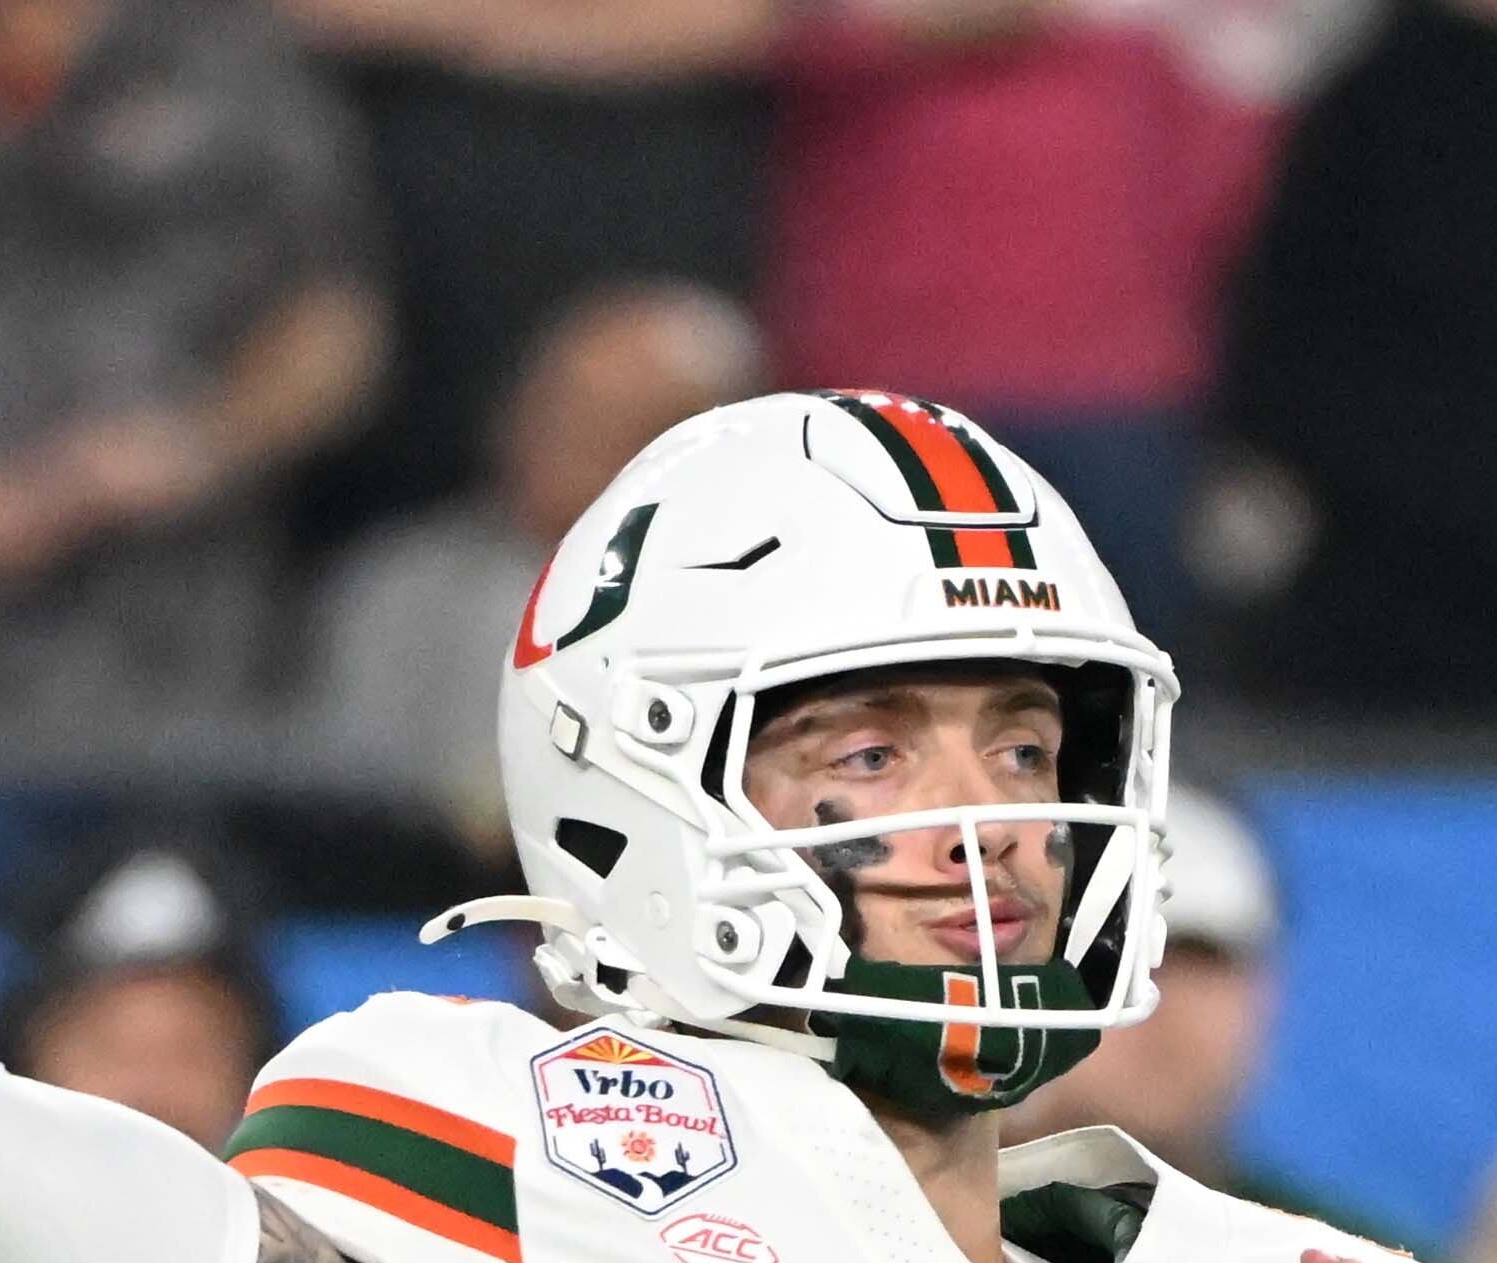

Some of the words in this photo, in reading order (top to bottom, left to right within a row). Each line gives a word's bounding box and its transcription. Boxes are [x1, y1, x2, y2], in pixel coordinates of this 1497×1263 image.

[941, 578, 1061, 612] MIAMI
[573, 1068, 674, 1100] Vrbo
[546, 1103, 634, 1128] Fiesta
[635, 1104, 728, 1139] Bowl
[678, 1228, 762, 1261] ACC
